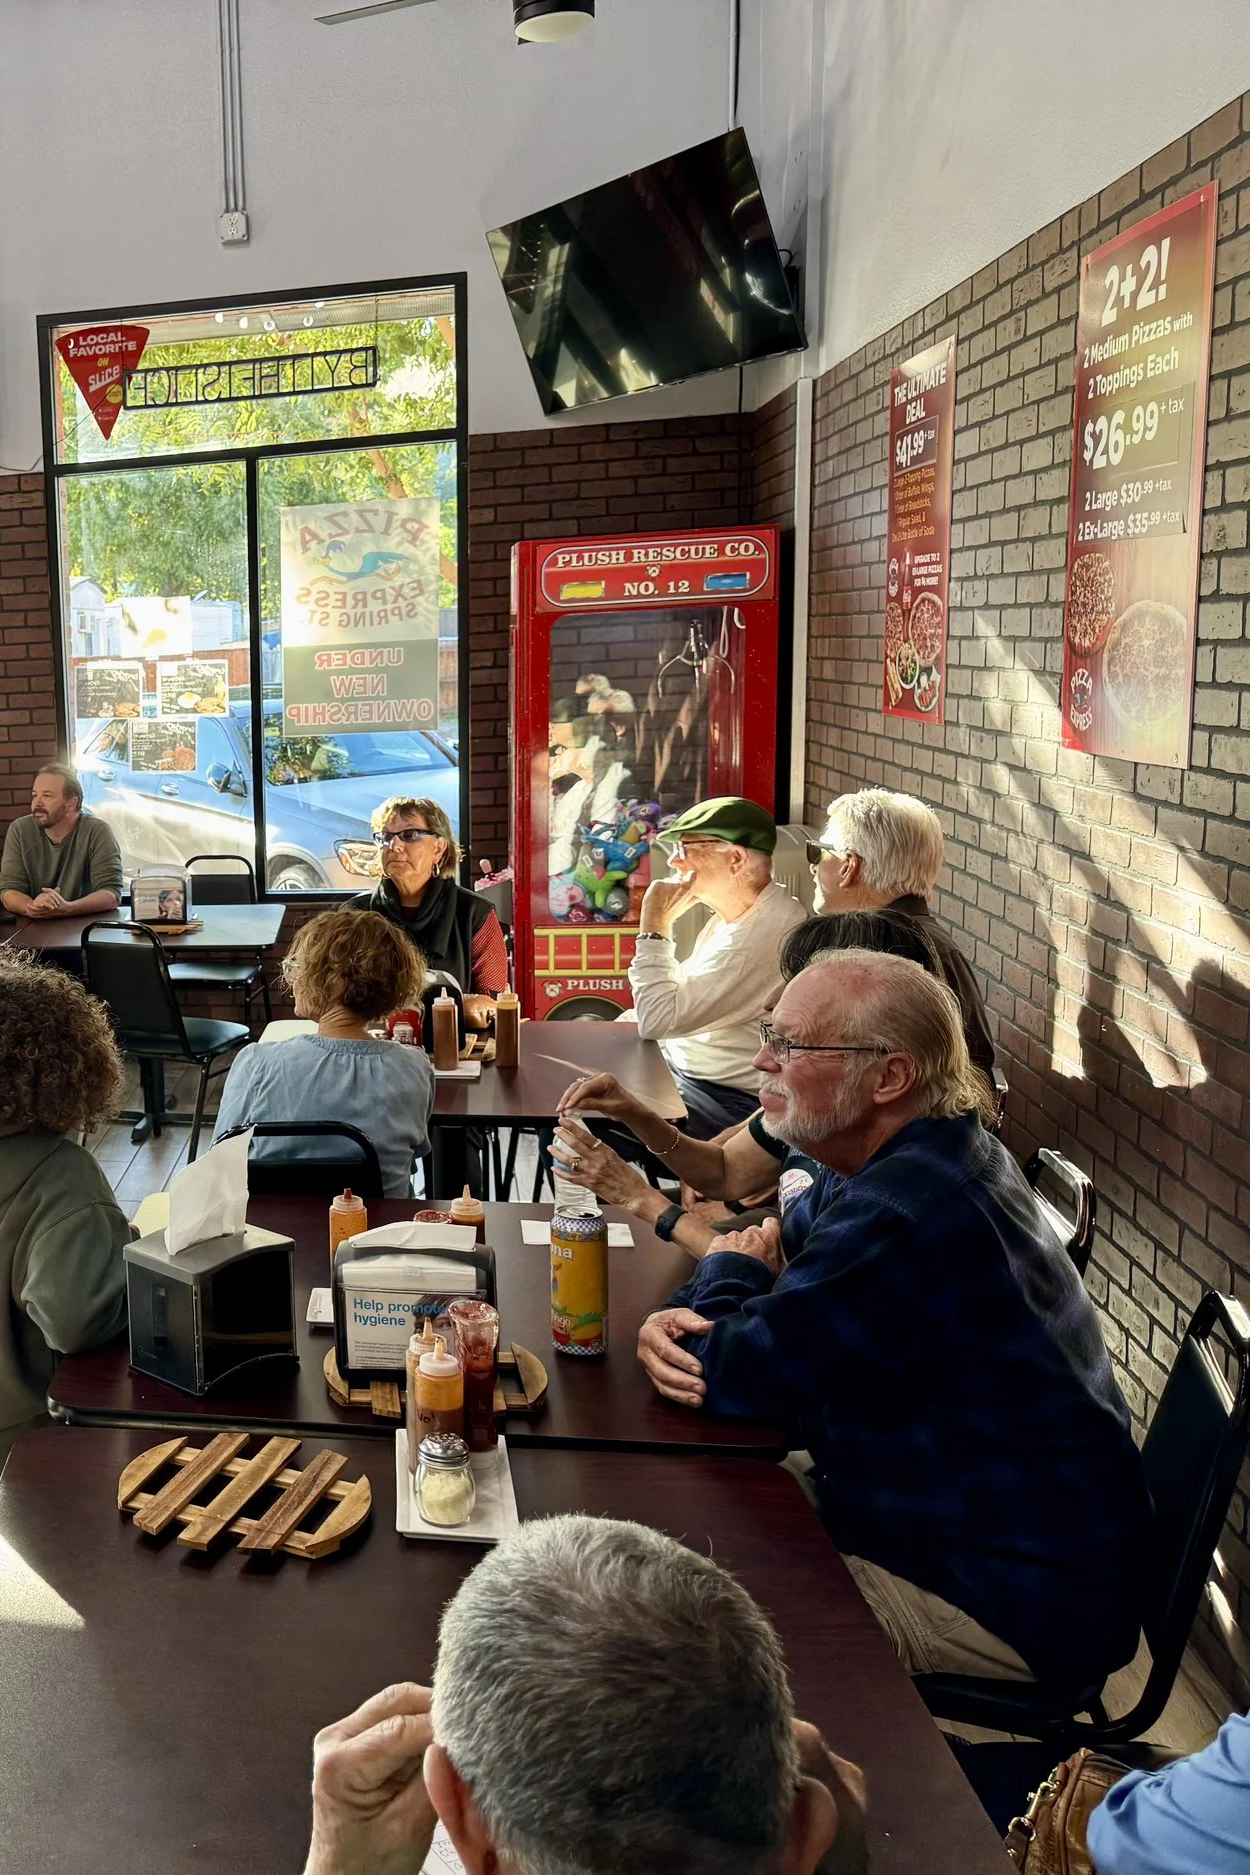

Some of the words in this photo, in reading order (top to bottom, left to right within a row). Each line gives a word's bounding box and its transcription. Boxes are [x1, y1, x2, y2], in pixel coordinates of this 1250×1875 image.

[1101, 236, 1171, 328] 2+2!
[69, 341, 137, 357] FAVORITE
[79, 332, 126, 345] LOCAL
[1083, 348, 1089, 369] 2
[1090, 331, 1129, 366] Medium
[1132, 314, 1172, 348] Pizzas
[1173, 312, 1193, 332] with
[97, 357, 109, 367] ON
[1088, 378, 1095, 400] 2
[1096, 363, 1144, 400] Toppings
[1147, 346, 1179, 378] Each
[894, 384, 906, 407] THE
[907, 361, 947, 396] ULTIMATE
[906, 397, 925, 424] DEAL
[1083, 400, 1158, 469] $26.99
[1168, 397, 1185, 414] tax
[896, 429, 924, 467] $41.99
[1085, 492, 1090, 512] 2
[1091, 484, 1118, 510] Large
[1120, 480, 1153, 508] $30.99
[1155, 478, 1172, 493] +tax
[1078, 523, 1083, 542] 2
[1084, 514, 1124, 542] Ex-Large
[1127, 510, 1160, 536] $35.99
[1162, 510, 1180, 524] +tax
[556, 550, 624, 567] PLUSH
[632, 544, 718, 563] RESCUE
[724, 542, 760, 557] CO.
[623, 581, 659, 596] NO.
[667, 580, 690, 594] 12
[1071, 668, 1093, 695] PIZZA
[1070, 708, 1093, 731] EXPRESS
[566, 980, 623, 990] PLUSH
[354, 1299, 383, 1312] Help
[388, 1302, 446, 1315] promote
[354, 1313, 406, 1326] hygiene
